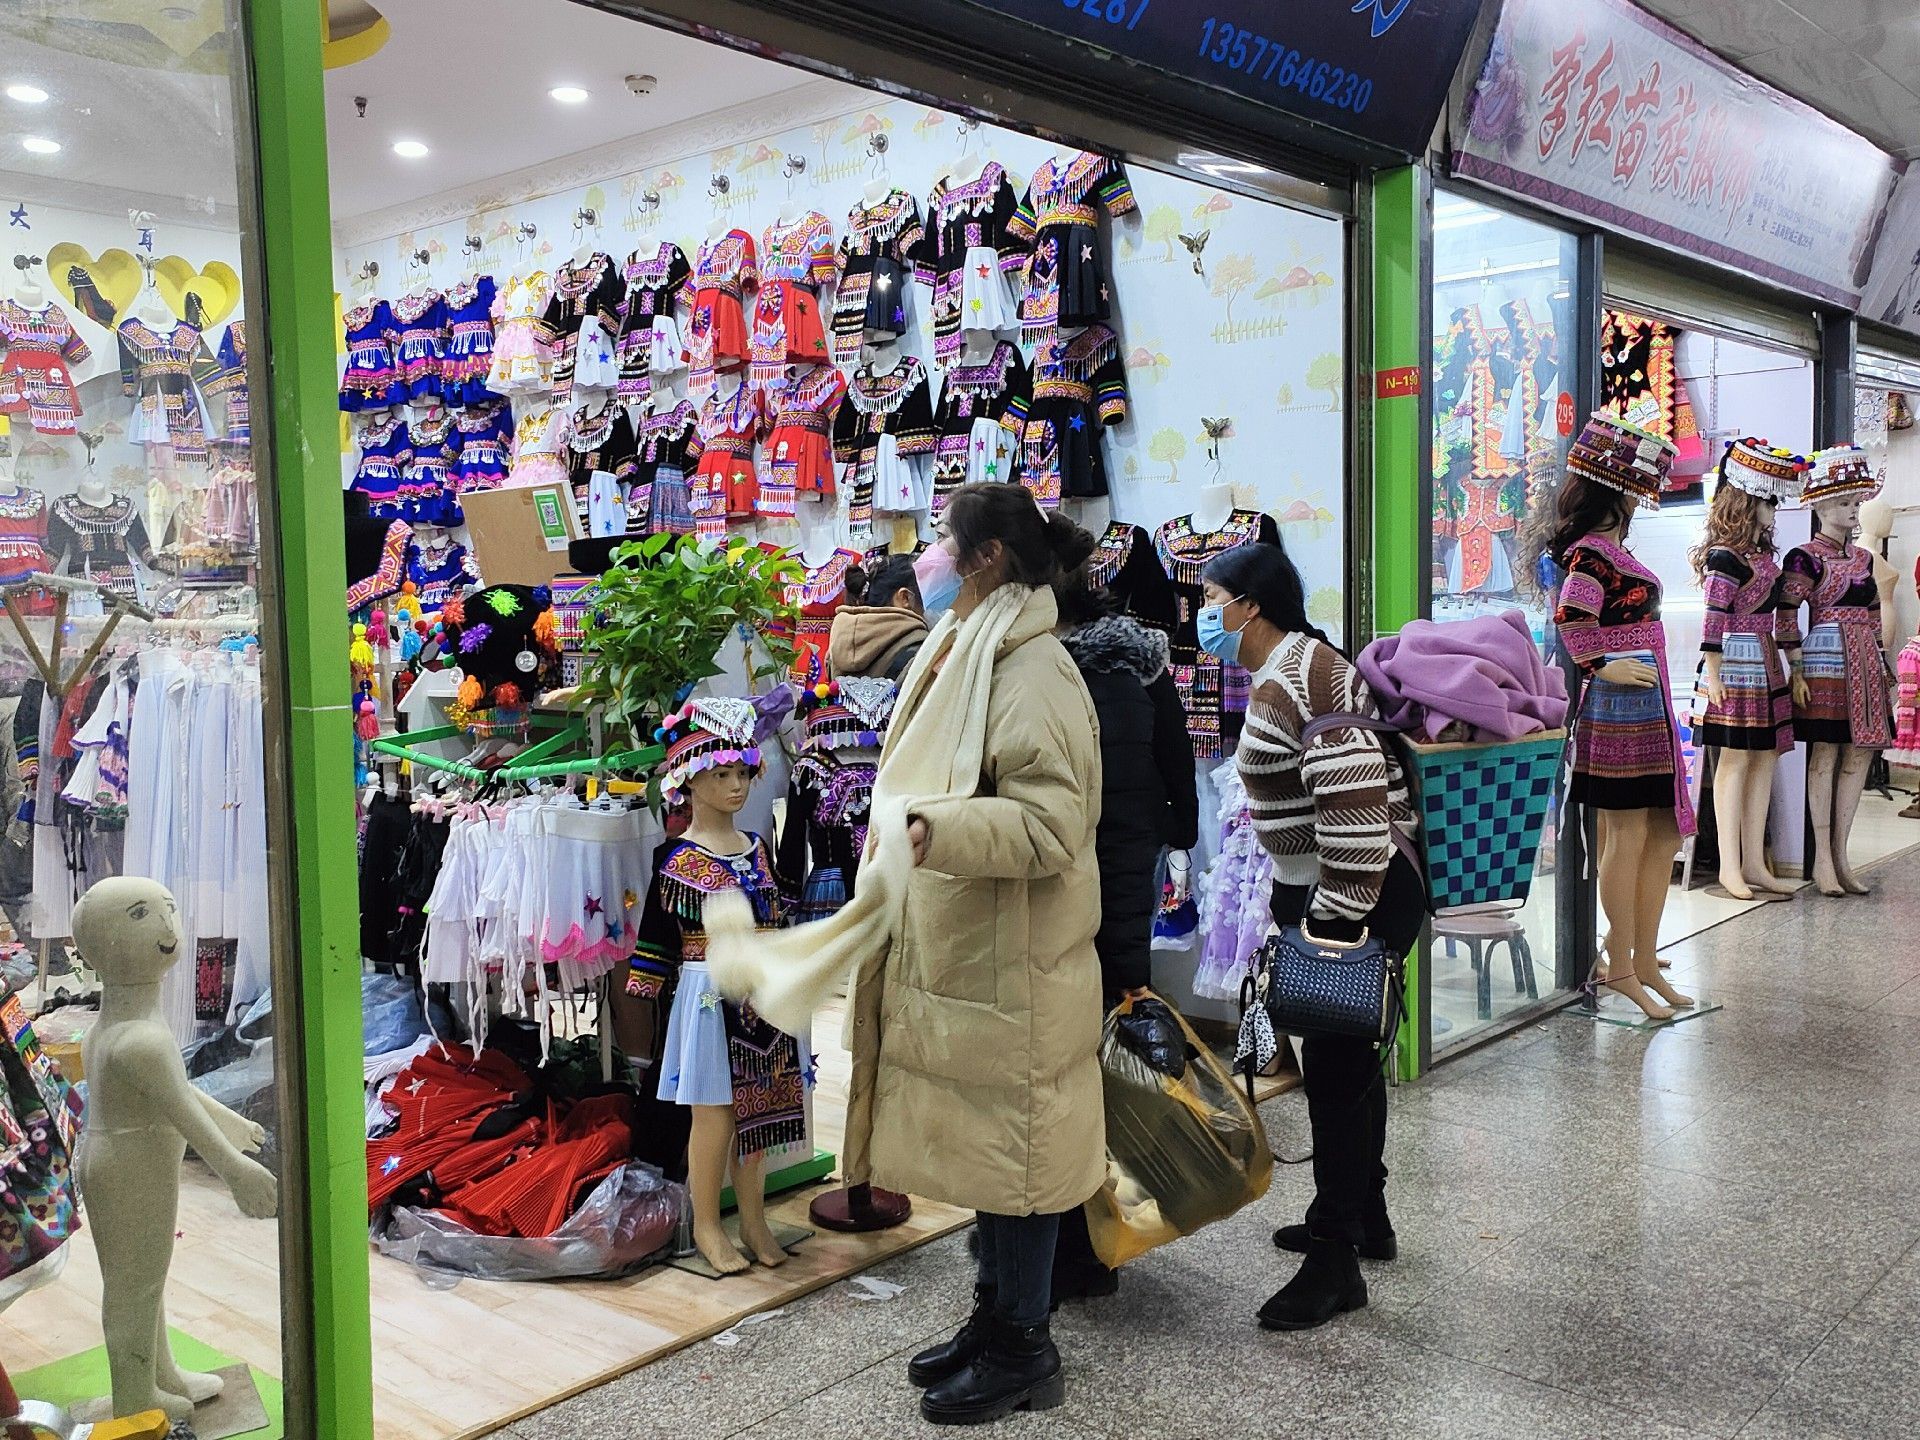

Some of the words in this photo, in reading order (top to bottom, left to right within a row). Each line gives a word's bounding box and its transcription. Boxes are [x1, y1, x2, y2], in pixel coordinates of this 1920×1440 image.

[1199, 17, 1373, 114] 13577646230
[9, 202, 31, 230] 大
[1557, 402, 1575, 426] 295
